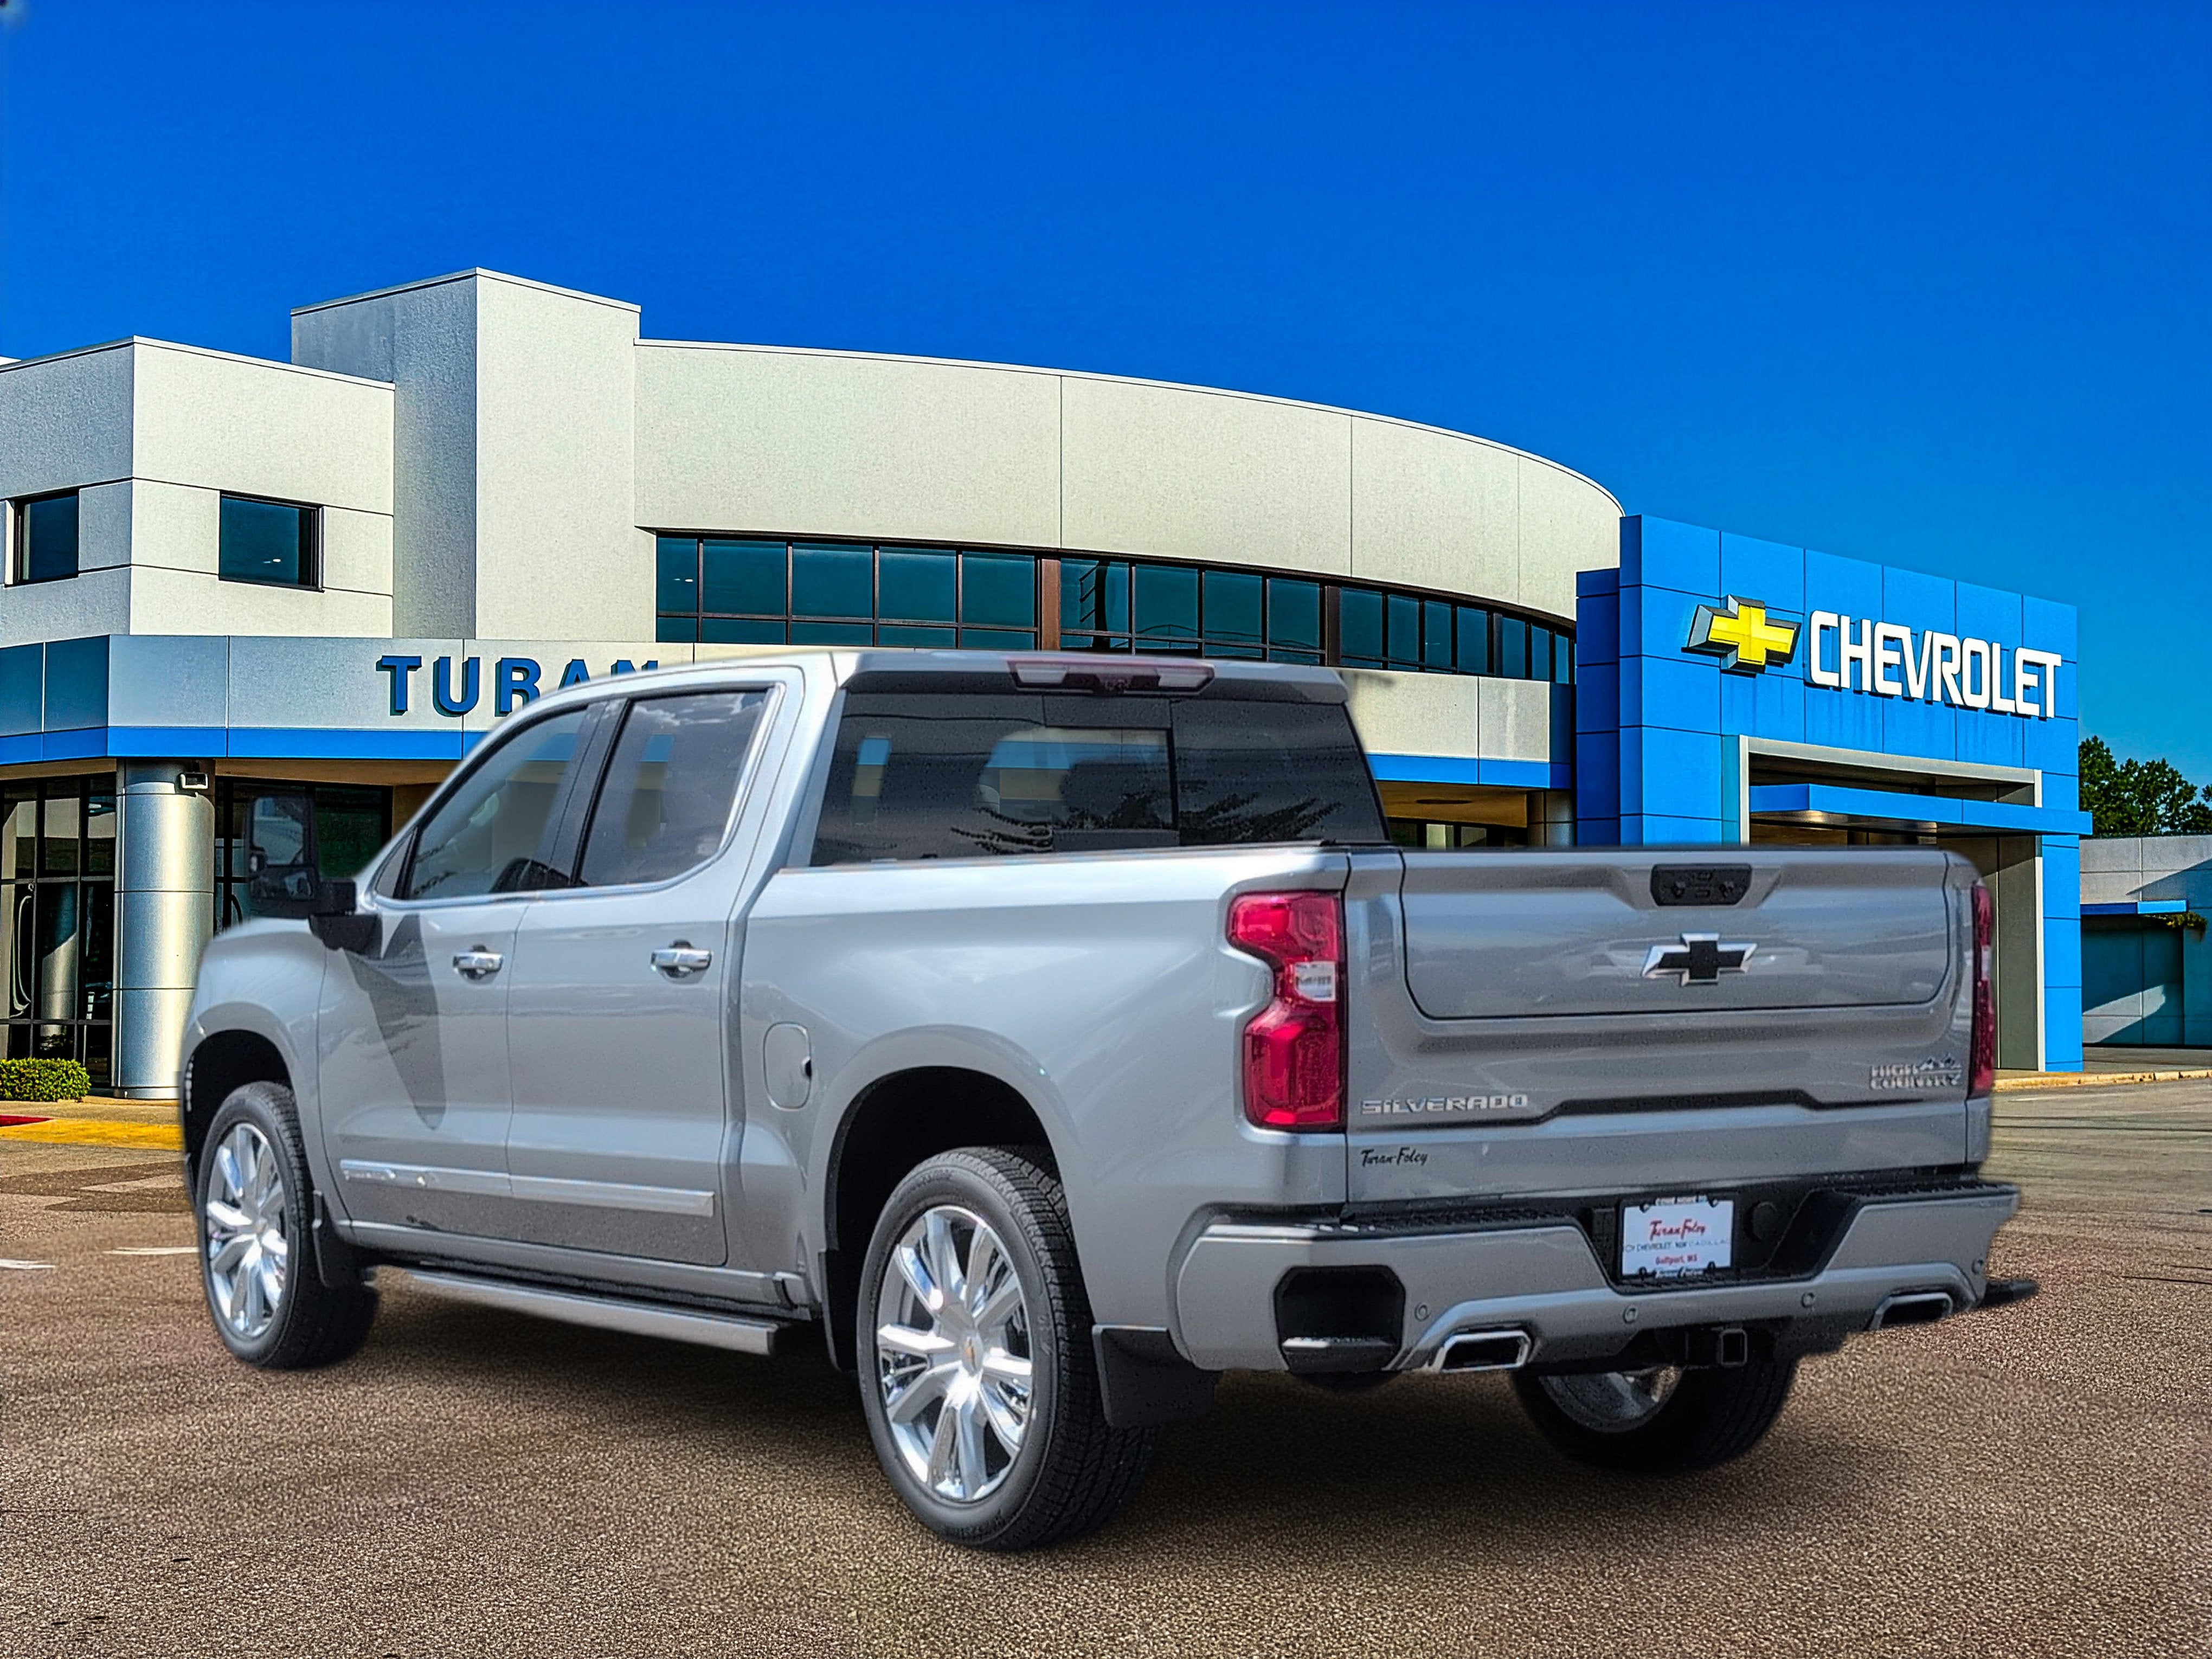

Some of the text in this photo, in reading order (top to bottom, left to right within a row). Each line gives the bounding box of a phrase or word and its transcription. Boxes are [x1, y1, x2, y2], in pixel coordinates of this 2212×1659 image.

[1809, 610, 2062, 719] CHEVROLET
[376, 655, 658, 717] TUR
[1361, 1094, 1528, 1115] SILVERADO
[1396, 1146, 1429, 1166] Foley
[1681, 1218, 1706, 1239] Foley
